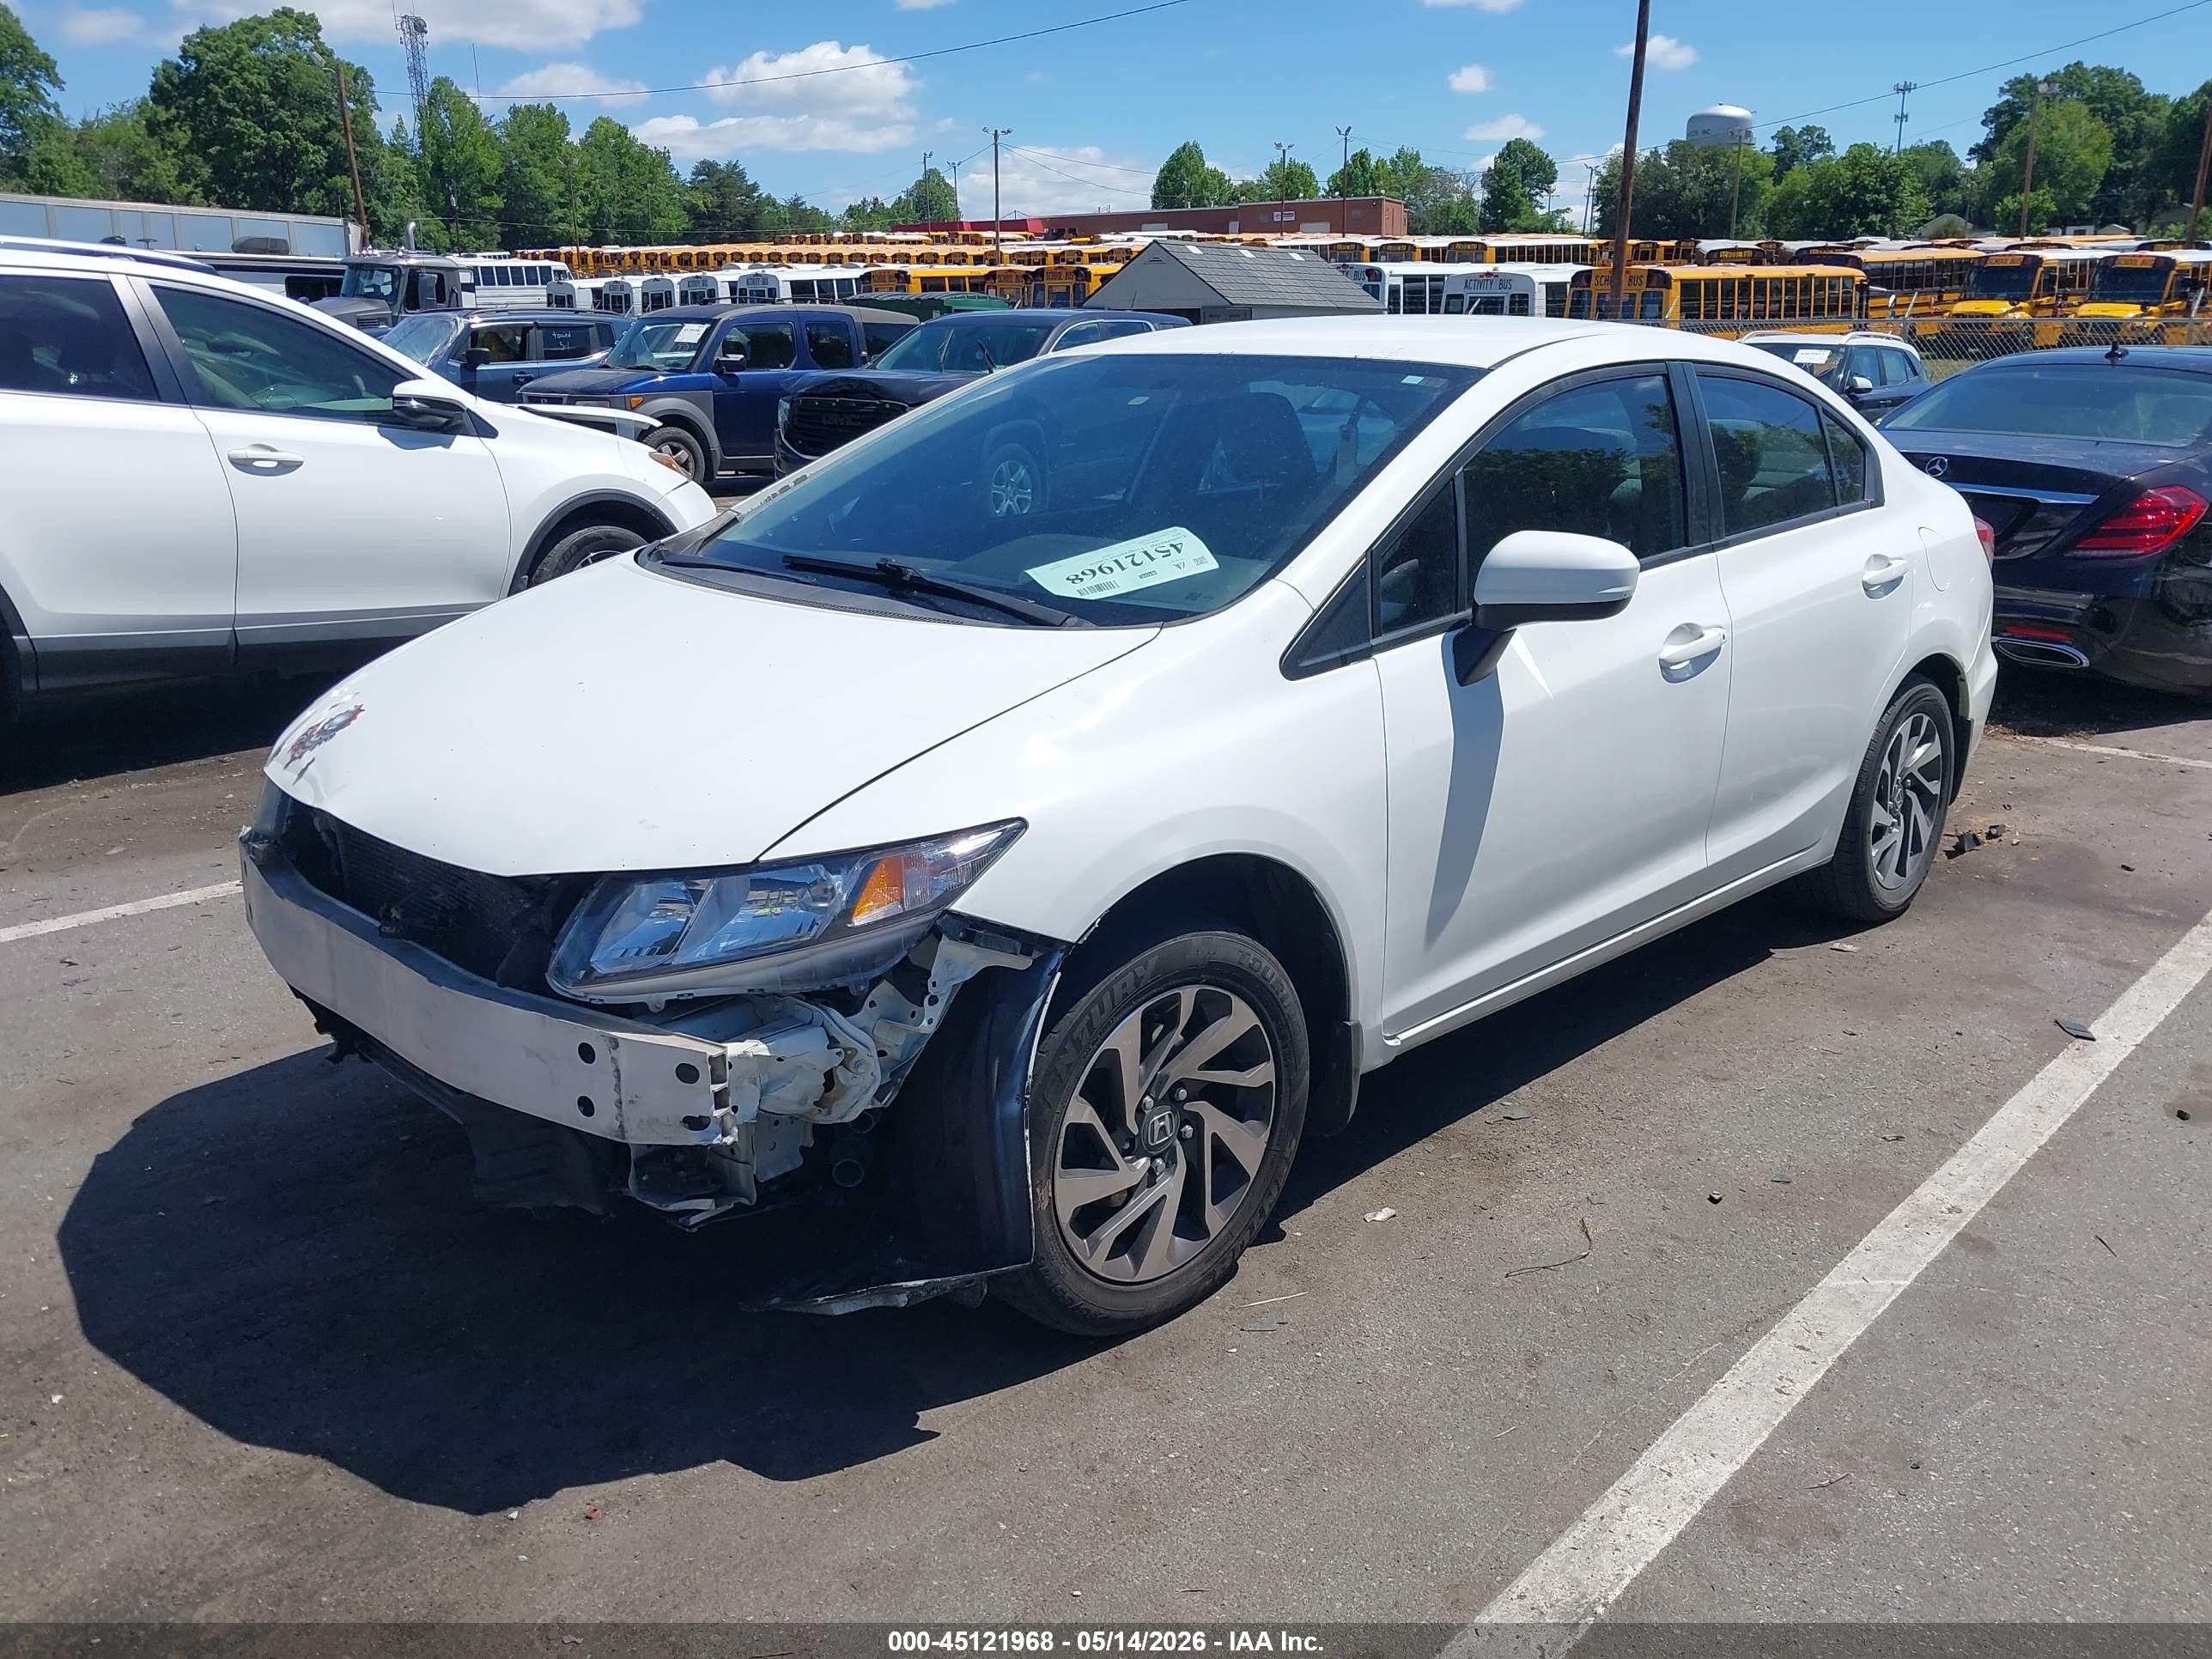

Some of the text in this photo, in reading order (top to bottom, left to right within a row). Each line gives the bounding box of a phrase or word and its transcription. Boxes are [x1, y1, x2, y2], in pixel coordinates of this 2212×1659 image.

[1352, 270, 1366, 281] BUS
[1627, 275, 1644, 287] BUS
[1463, 278, 1512, 290] ACTIVITY BUS
[1065, 541, 1185, 586] 45121968
